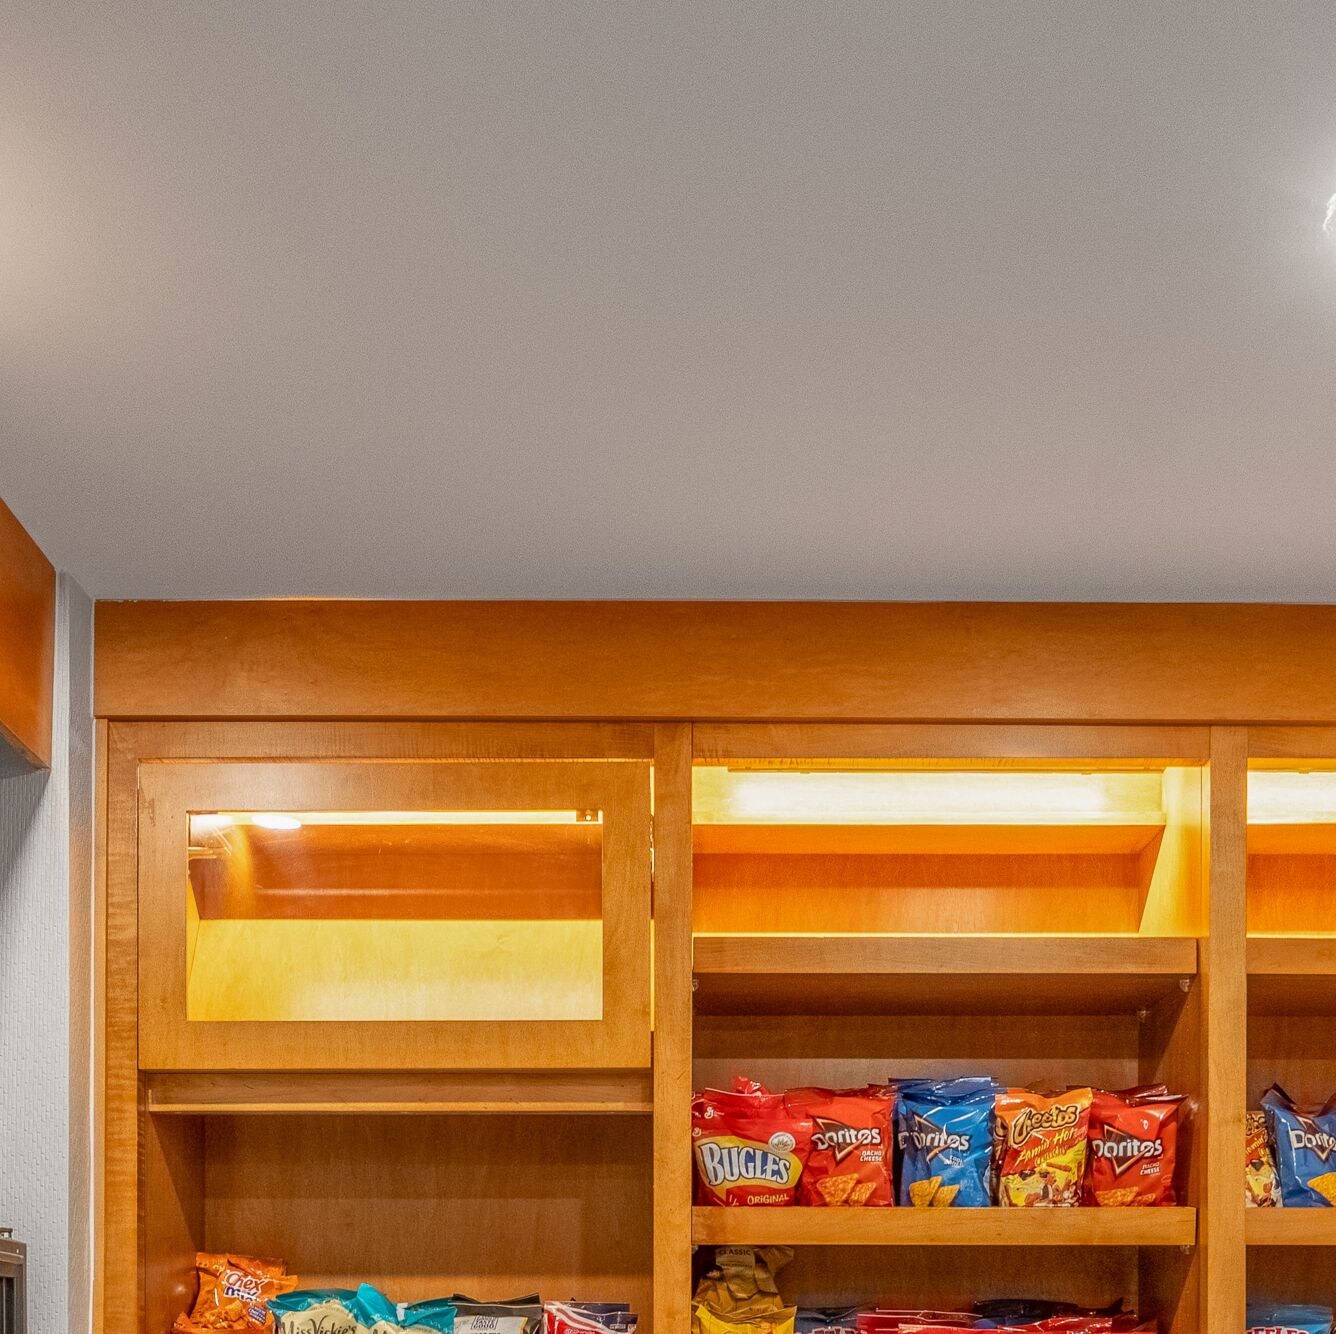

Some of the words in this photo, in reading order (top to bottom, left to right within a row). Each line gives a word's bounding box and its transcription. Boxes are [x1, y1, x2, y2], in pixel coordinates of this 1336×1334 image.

[811, 1128, 881, 1150] Doritos
[1092, 1139, 1163, 1157] Doritos
[699, 1142, 791, 1186] BUGLES
